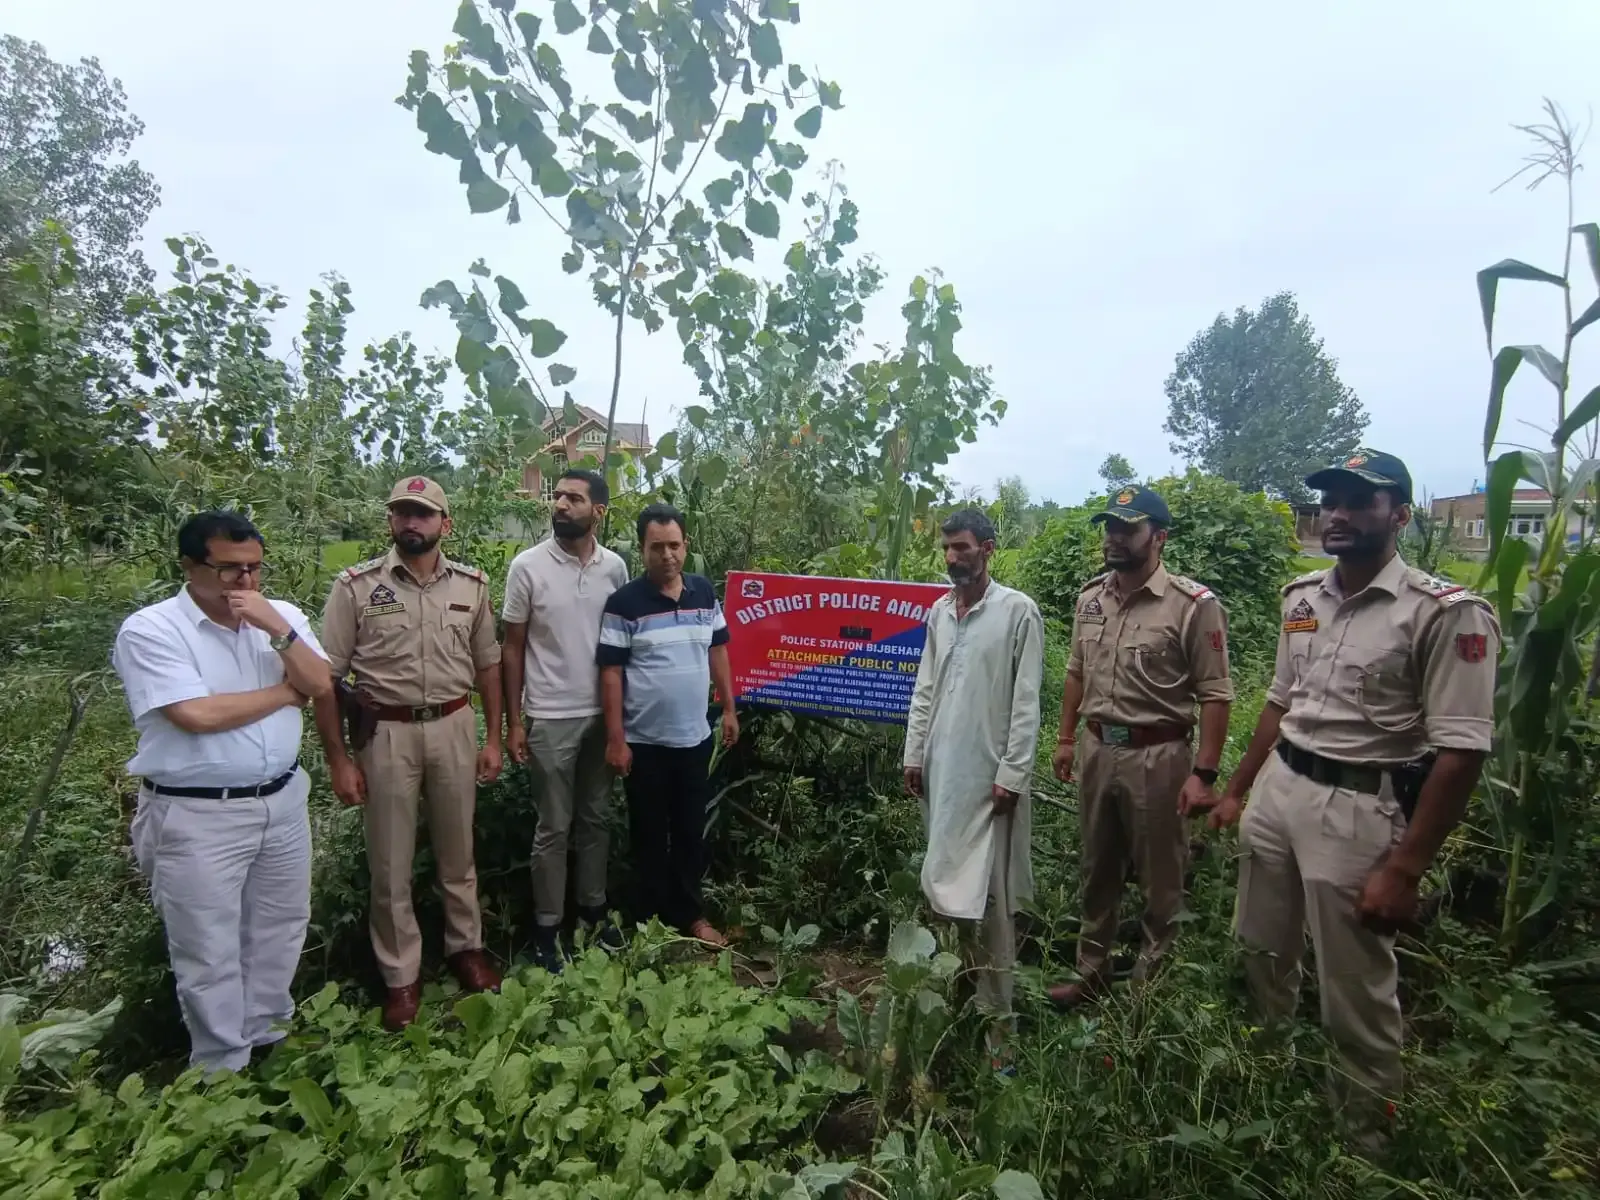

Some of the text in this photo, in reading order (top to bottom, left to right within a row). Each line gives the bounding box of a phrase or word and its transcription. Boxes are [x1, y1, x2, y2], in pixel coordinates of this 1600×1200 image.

[736, 594, 812, 624] DISTRICT
[819, 592, 880, 612] POLICE
[780, 634, 922, 656] POLICE STATION BIJBEHAR
[768, 648, 921, 672] ATTACHMENT PUBLIC NO
